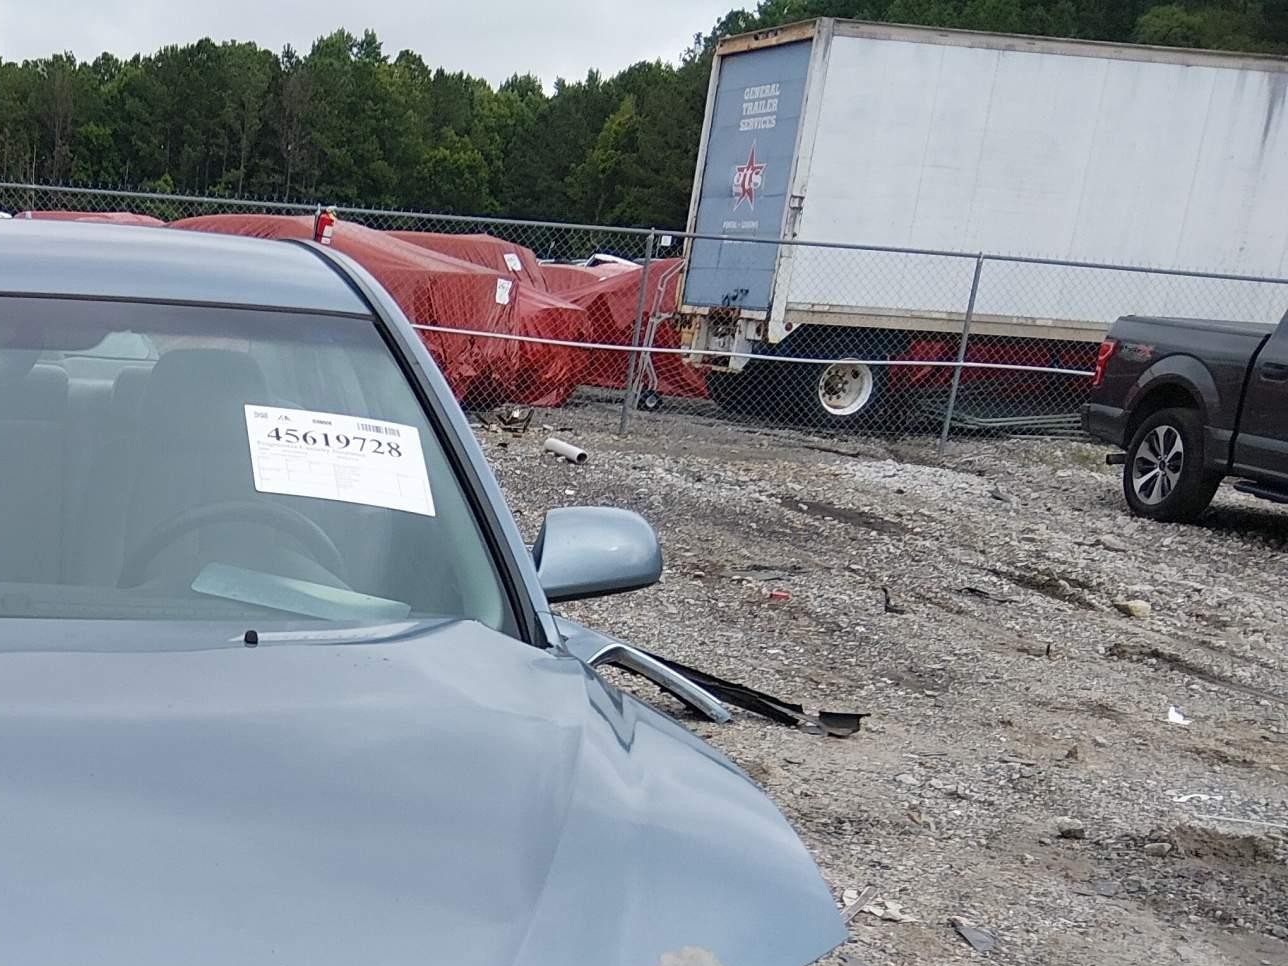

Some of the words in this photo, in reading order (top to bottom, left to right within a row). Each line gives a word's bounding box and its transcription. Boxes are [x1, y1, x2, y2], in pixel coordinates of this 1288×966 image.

[743, 83, 781, 100] GENERAL
[742, 98, 779, 116] TRAILER
[739, 115, 777, 131] SERVICES
[267, 427, 402, 458] 45619728
